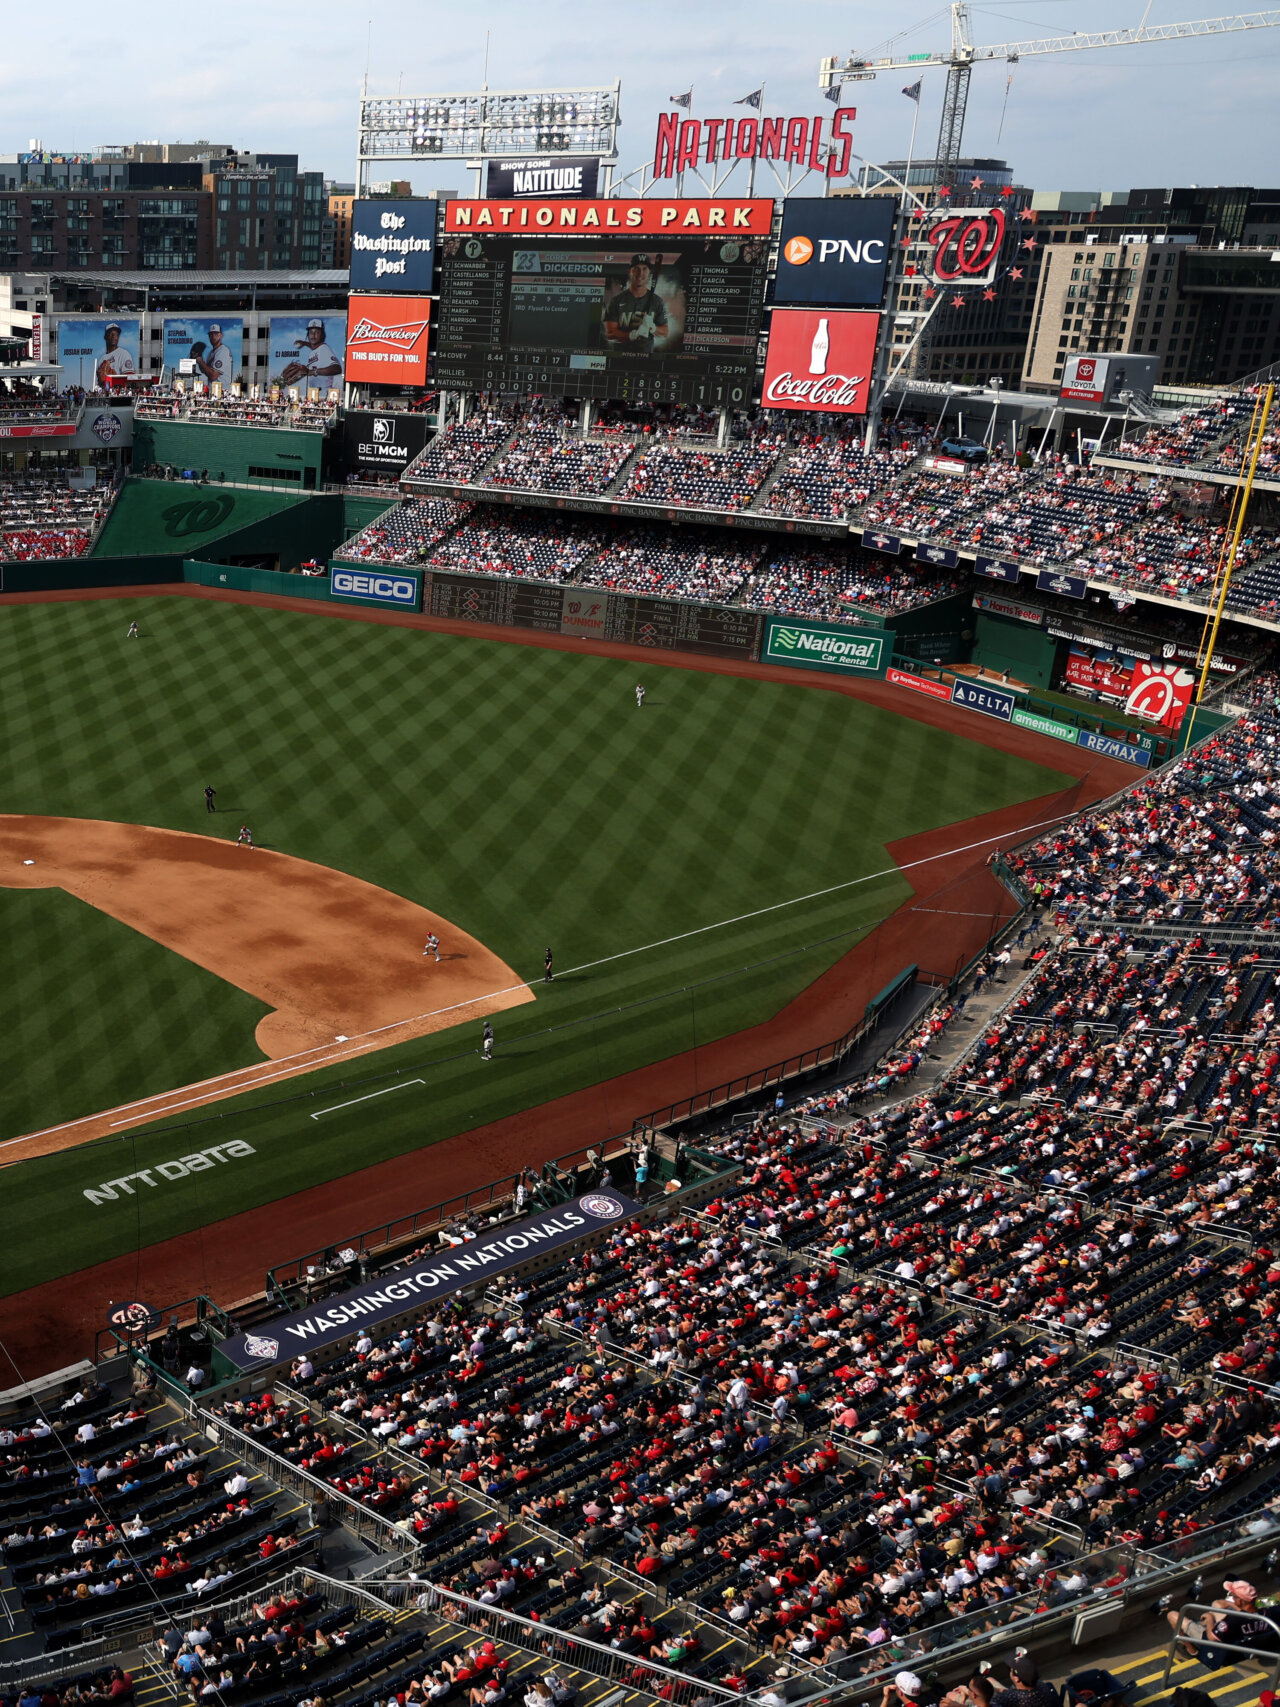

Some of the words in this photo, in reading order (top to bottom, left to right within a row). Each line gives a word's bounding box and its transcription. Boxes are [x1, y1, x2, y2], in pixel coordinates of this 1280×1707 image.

[653, 107, 856, 178] NATIONALS
[501, 162, 526, 171] SHOW
[527, 160, 551, 170] SOME
[513, 167, 583, 193] NATITUDE
[380, 212, 406, 230] The
[455, 208, 643, 227] NATIONALS
[661, 208, 753, 227] PARK
[353, 232, 431, 255] Washington
[817, 239, 884, 264] PNC
[375, 257, 407, 278] Post
[543, 263, 603, 273] DICKERSON
[353, 321, 419, 340] Budweiser
[281, 350, 300, 358] ABRAMS
[352, 351, 367, 361] THIS
[368, 352, 389, 362] BUD'S
[389, 353, 404, 363] FOR
[404, 353, 421, 363] YOU.
[532, 355, 540, 363] 12
[552, 356, 560, 364] 17
[715, 365, 733, 373] 5:22
[734, 366, 747, 374] PM
[437, 379, 473, 387] NATIONALS
[766, 372, 866, 406] Coca-Cola
[1070, 380, 1096, 390] TOYOTA
[731, 388, 742, 401] 0
[358, 443, 408, 457] BETMGM
[1165, 468, 1203, 480] ROBINSON
[411, 485, 426, 494] PNC
[426, 487, 448, 496] BANK
[461, 490, 476, 499] PNC
[477, 492, 498, 501] BANK
[512, 495, 528, 504] PNC
[529, 497, 551, 506] BANK
[564, 500, 580, 509] PNC
[582, 502, 604, 511] BANK
[620, 506, 637, 515] PNC
[637, 508, 661, 517] BANK
[676, 511, 694, 520] PNC
[694, 513, 718, 523] BANK
[734, 517, 753, 526] PNC
[753, 519, 778, 529] BANK
[795, 523, 815, 532] PNC
[816, 525, 841, 535] BANK
[333, 573, 413, 599] GEICO
[654, 603, 673, 611] FINAL
[989, 600, 1014, 615] Harris
[1014, 606, 1041, 622] Teeter
[1045, 615, 1062, 627] 5:22
[1047, 627, 1073, 640] NATIONALS
[796, 633, 875, 658] National
[821, 652, 837, 662] Car
[839, 656, 869, 666] Rental
[900, 675, 920, 687] Raytheon
[968, 691, 1010, 714] DELTA
[1015, 713, 1067, 737] amentum
[1087, 736, 1139, 762] RE/MAX
[1141, 739, 1151, 749] 335
[284, 1263, 460, 1342] WASHINGTON
[454, 1211, 586, 1272] NATIONALS
